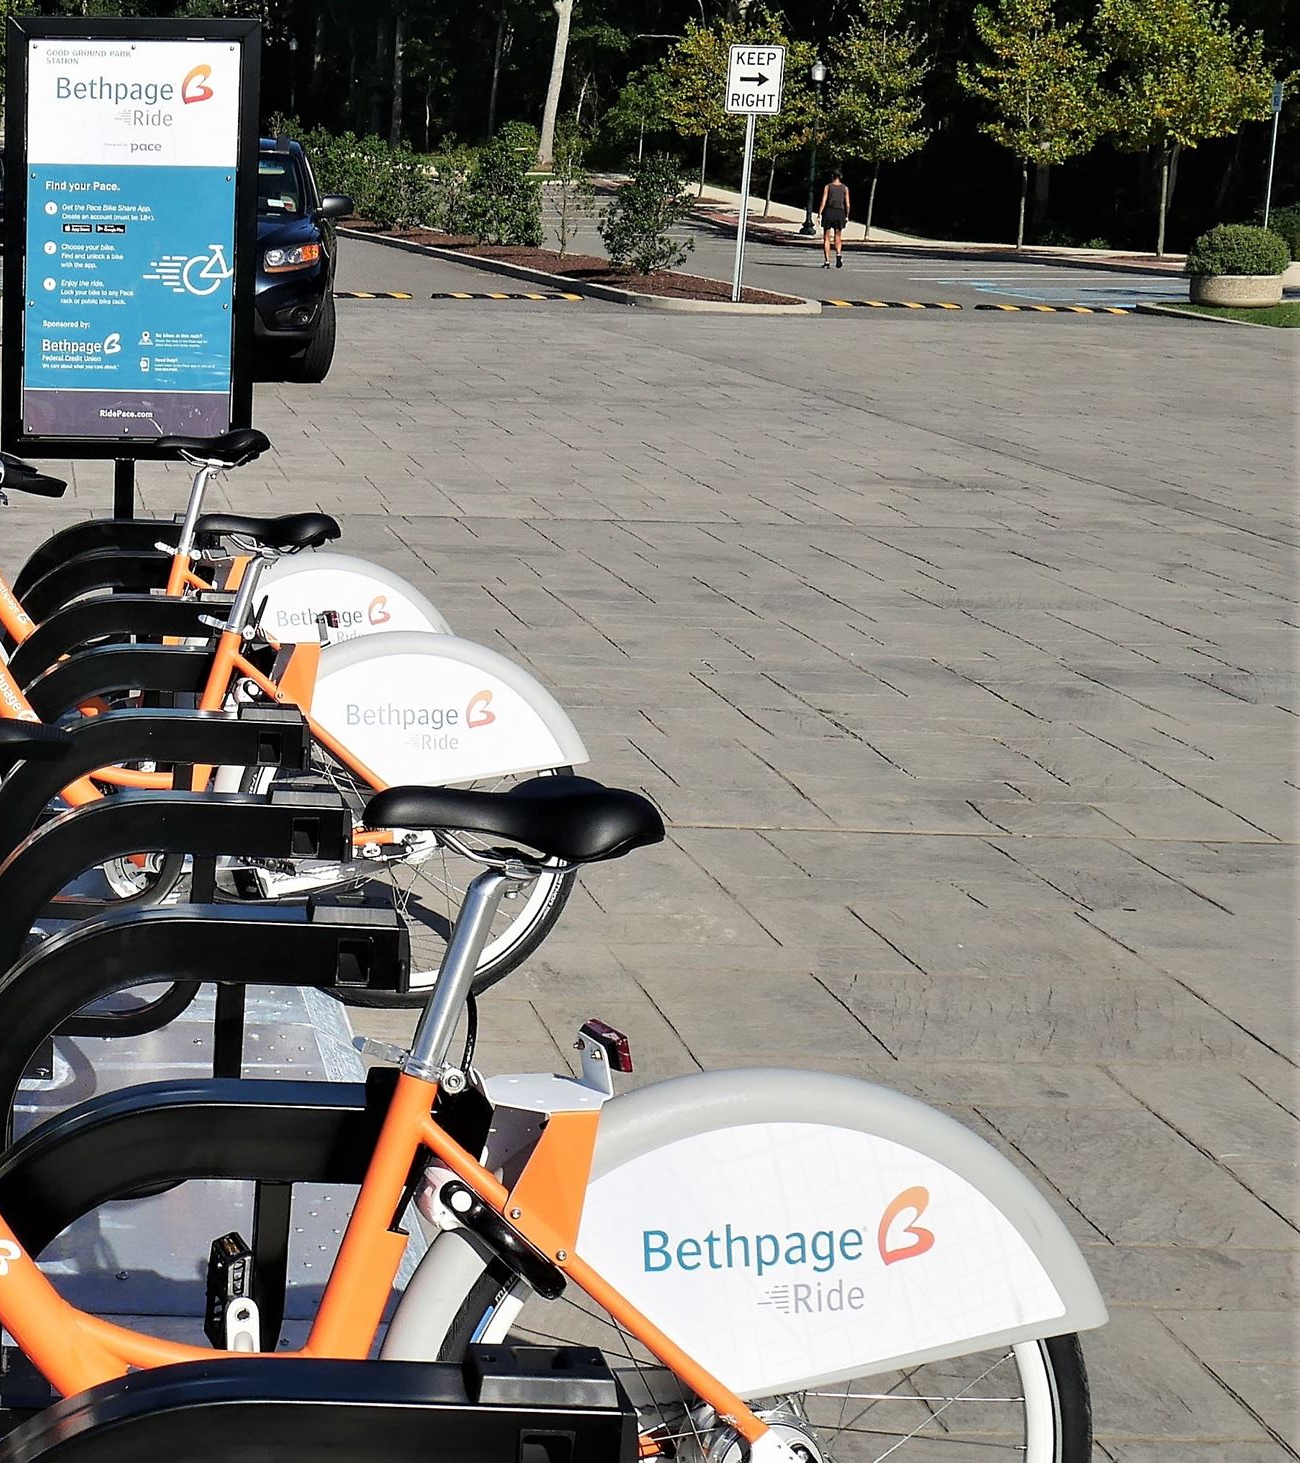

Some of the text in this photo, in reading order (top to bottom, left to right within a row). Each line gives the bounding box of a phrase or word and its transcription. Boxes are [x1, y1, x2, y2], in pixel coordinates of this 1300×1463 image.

[736, 52, 777, 66] KEEP
[56, 76, 174, 106] Bethpage
[731, 93, 776, 108] RIGHT
[134, 109, 173, 126] Ride
[130, 143, 162, 153] pace
[45, 181, 120, 192] Find your Pace.
[137, 205, 151, 213] App.
[43, 320, 91, 329] Sponsored by:
[42, 339, 101, 354] Bethpage
[100, 410, 153, 418] RidePace.com
[277, 608, 363, 627] Bethge
[337, 630, 364, 640] Rid
[346, 703, 459, 729] Bethpage
[422, 734, 459, 750] Ride
[643, 1224, 863, 1275] Bethpage
[794, 1279, 865, 1314] Ride
